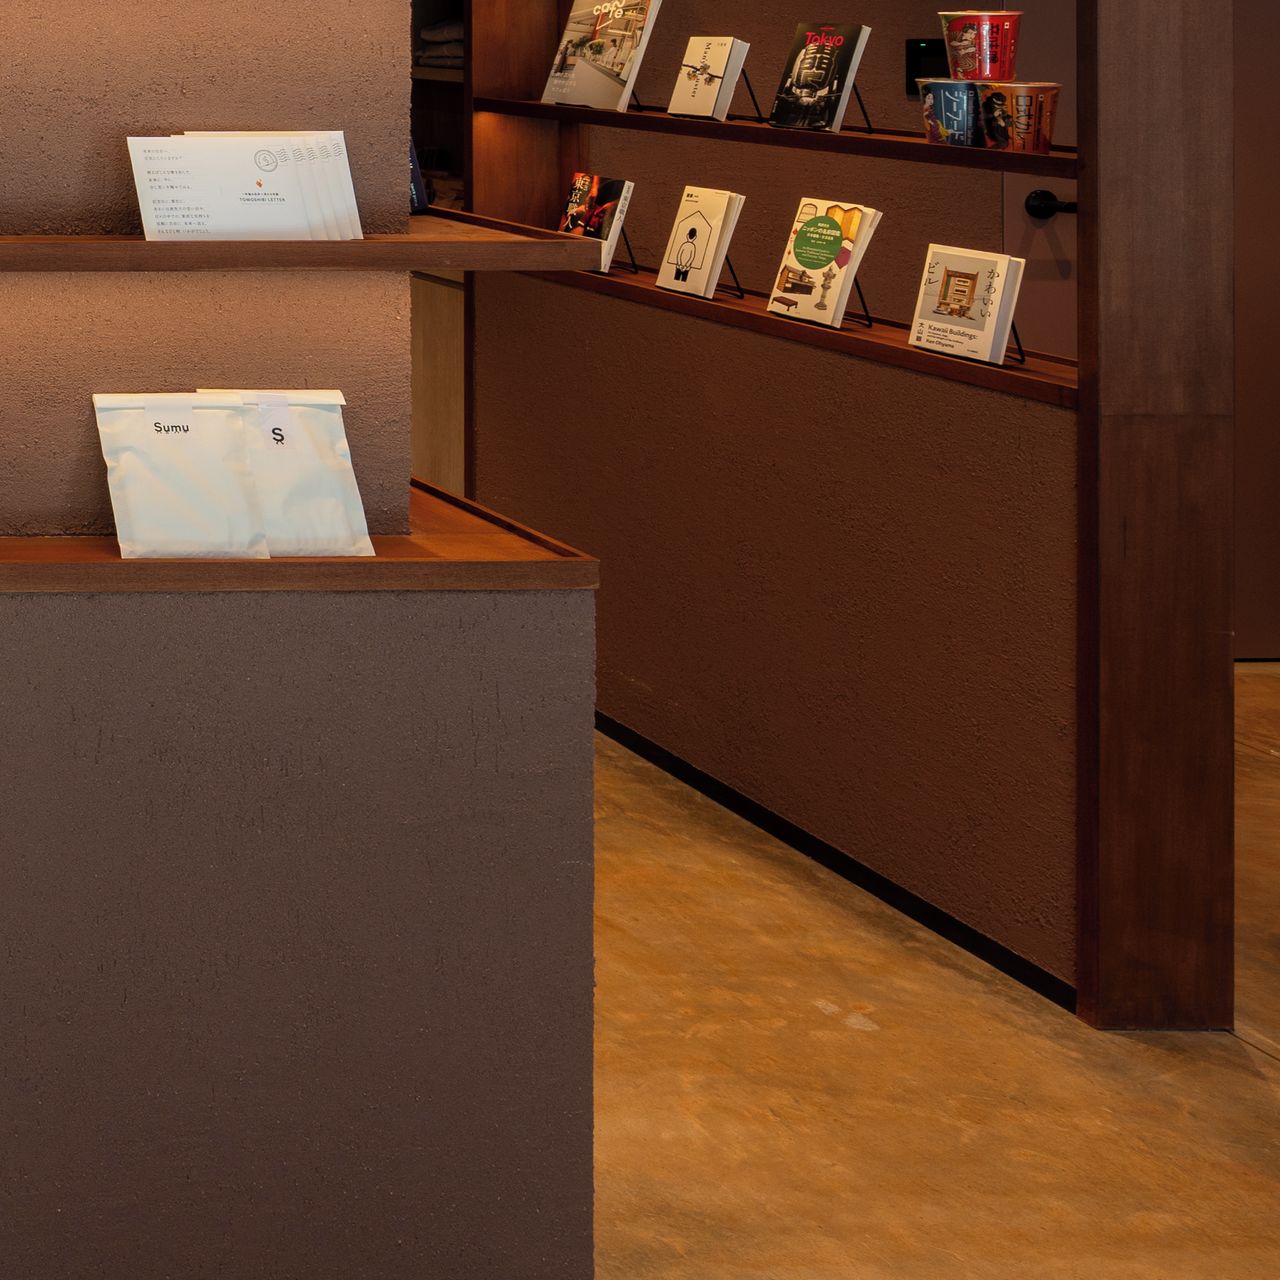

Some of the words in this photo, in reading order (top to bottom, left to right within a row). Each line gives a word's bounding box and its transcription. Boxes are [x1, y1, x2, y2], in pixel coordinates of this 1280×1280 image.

[592, 1, 623, 19] cafe
[805, 31, 844, 49] Tokyo
[924, 261, 940, 286] ビル
[980, 268, 1000, 318] かわいい
[928, 324, 949, 334] Kawaii
[935, 340, 955, 350] Ohyama
[153, 421, 190, 434] Sumu
[271, 427, 286, 445] S
